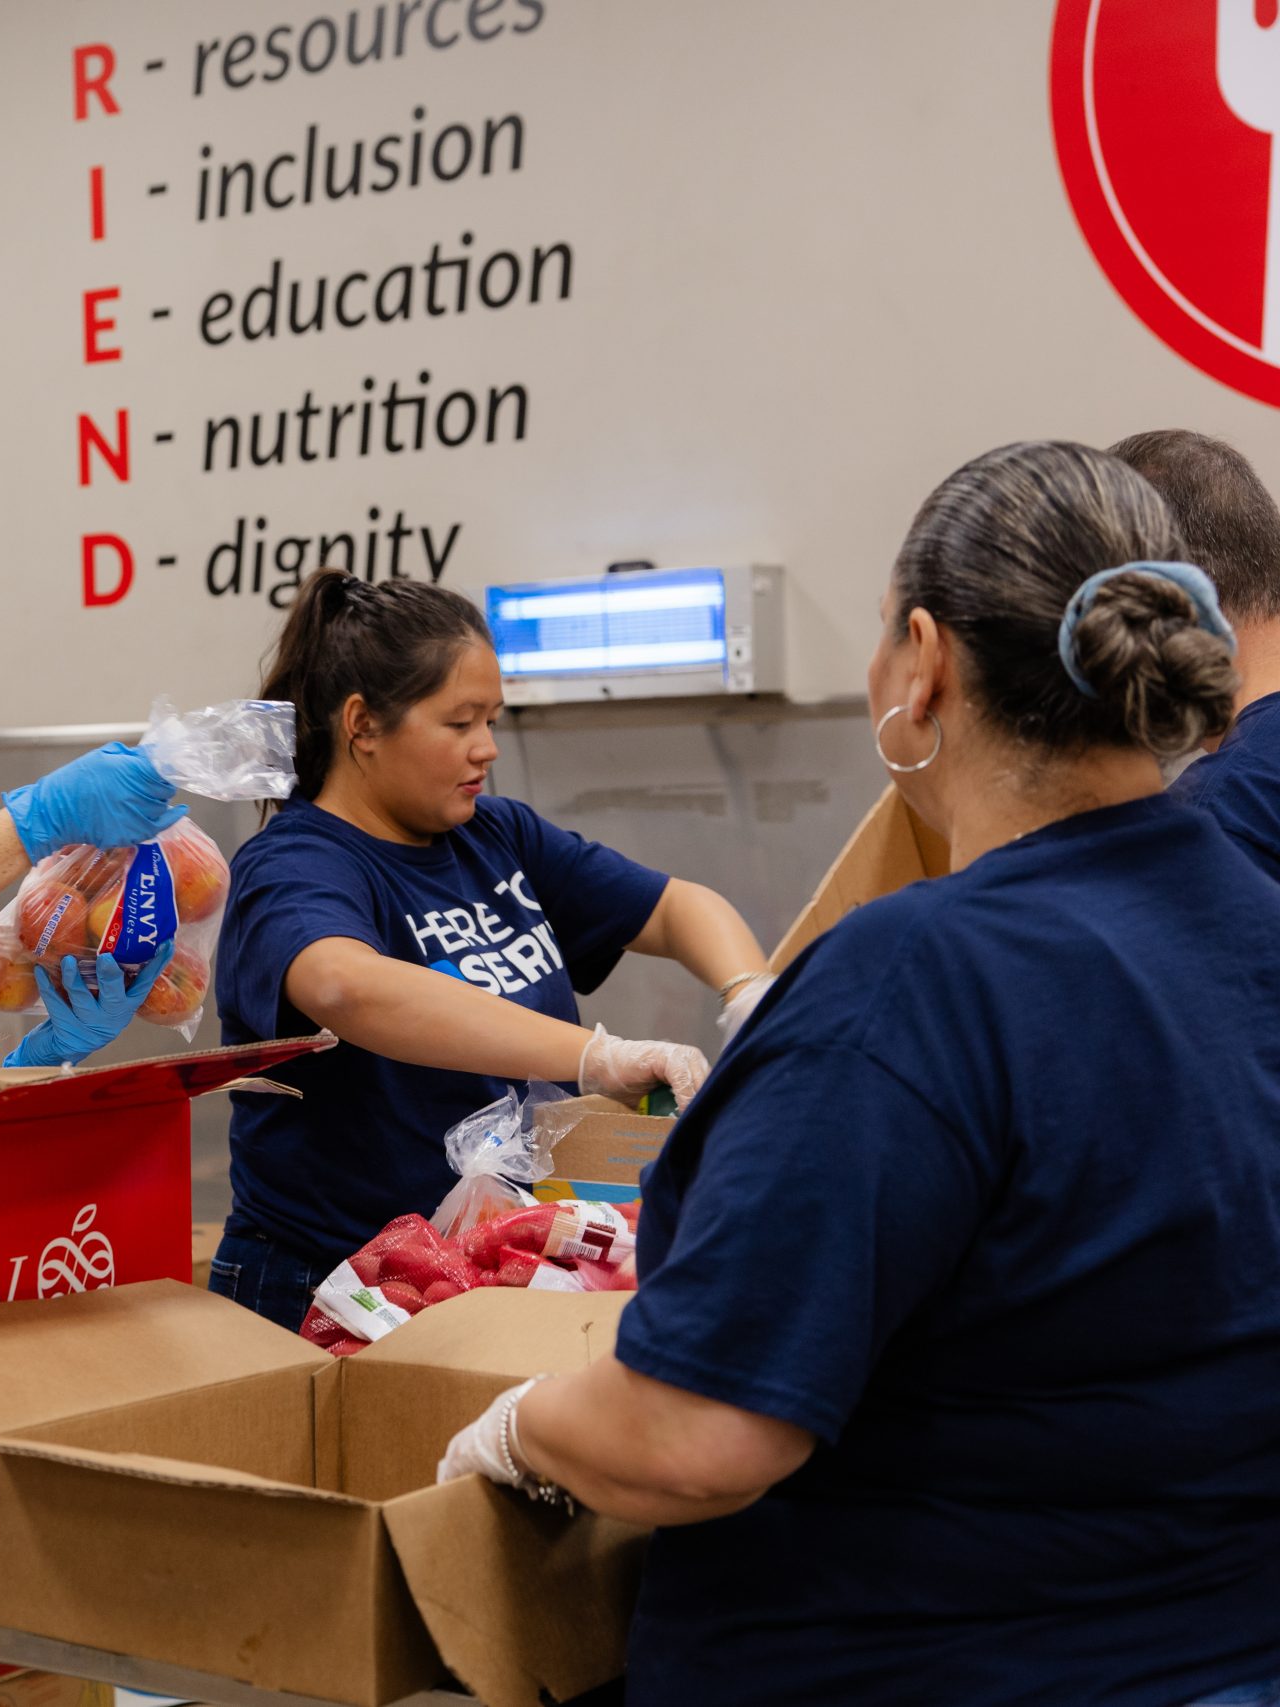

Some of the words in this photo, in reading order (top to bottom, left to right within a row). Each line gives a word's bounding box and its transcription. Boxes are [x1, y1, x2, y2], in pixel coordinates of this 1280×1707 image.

[72, 43, 121, 122] R
[192, 0, 545, 97] resources
[89, 164, 107, 243] I
[196, 105, 526, 223] inclusion
[81, 285, 124, 366] E
[198, 230, 574, 348] education
[76, 407, 132, 489] N
[202, 368, 530, 474] nutrition
[80, 531, 137, 610] D
[138, 872, 159, 946] ENVY
[405, 902, 516, 957] HERE
[459, 920, 564, 996] SERV
